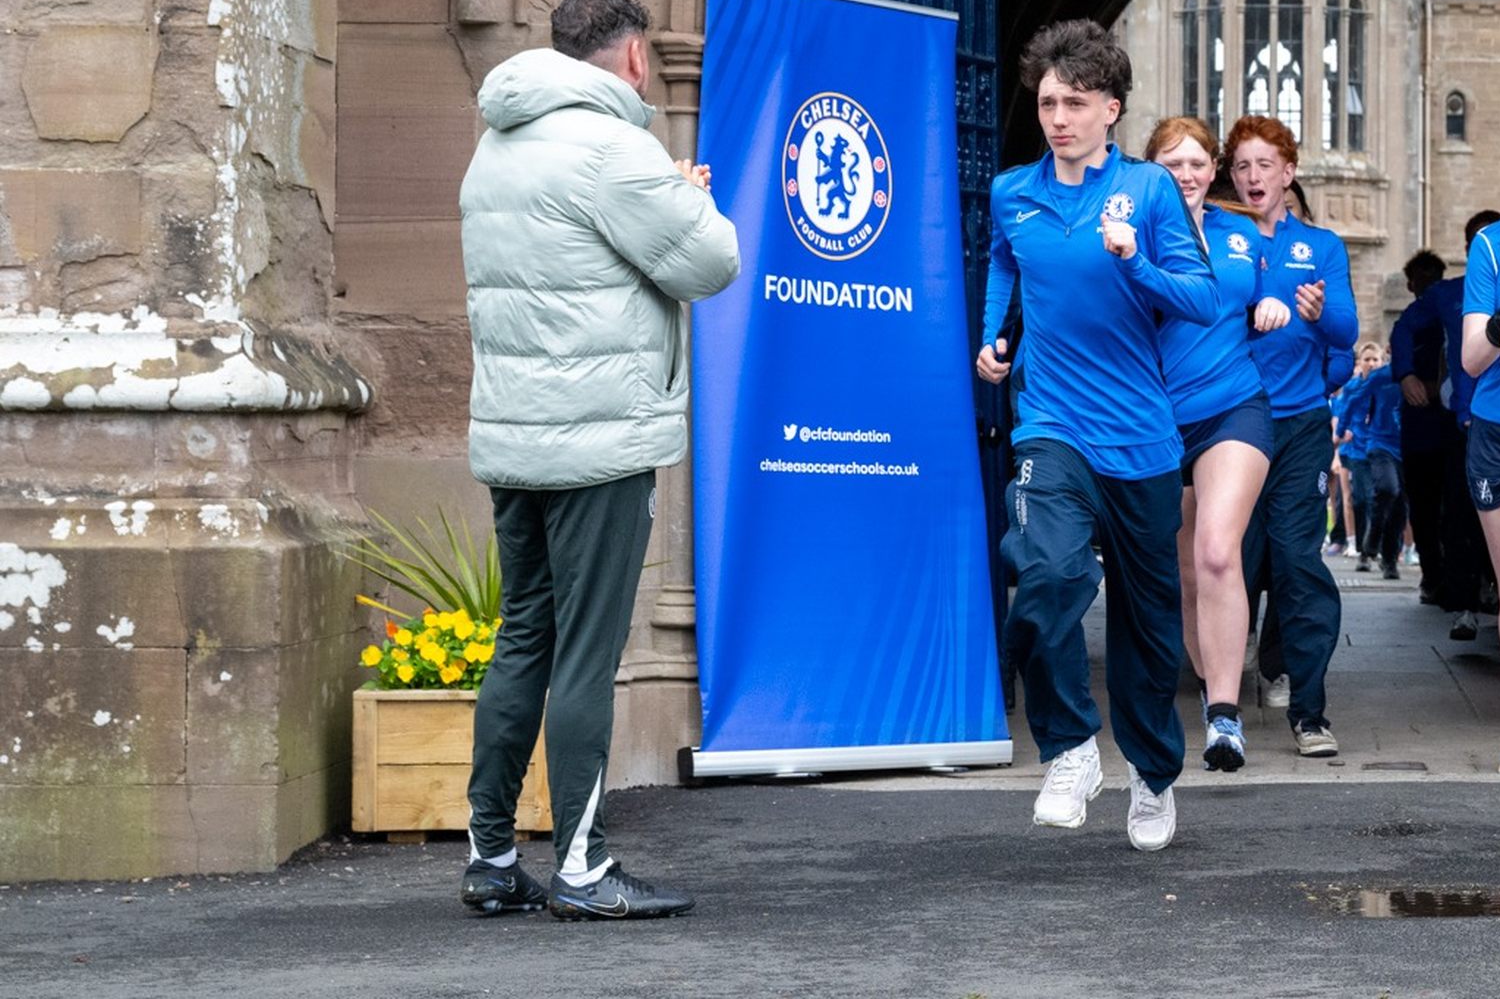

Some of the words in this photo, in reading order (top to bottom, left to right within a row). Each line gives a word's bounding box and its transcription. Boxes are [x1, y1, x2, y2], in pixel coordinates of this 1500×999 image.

[801, 98, 870, 140] CHELSEA
[797, 216, 844, 251] FOOTBALL
[848, 223, 873, 248] CLUB
[765, 275, 913, 312] FOUNDATION
[800, 426, 891, 443] @cfcfoundation
[760, 459, 919, 475] chelseasoccerschools.co.uk
